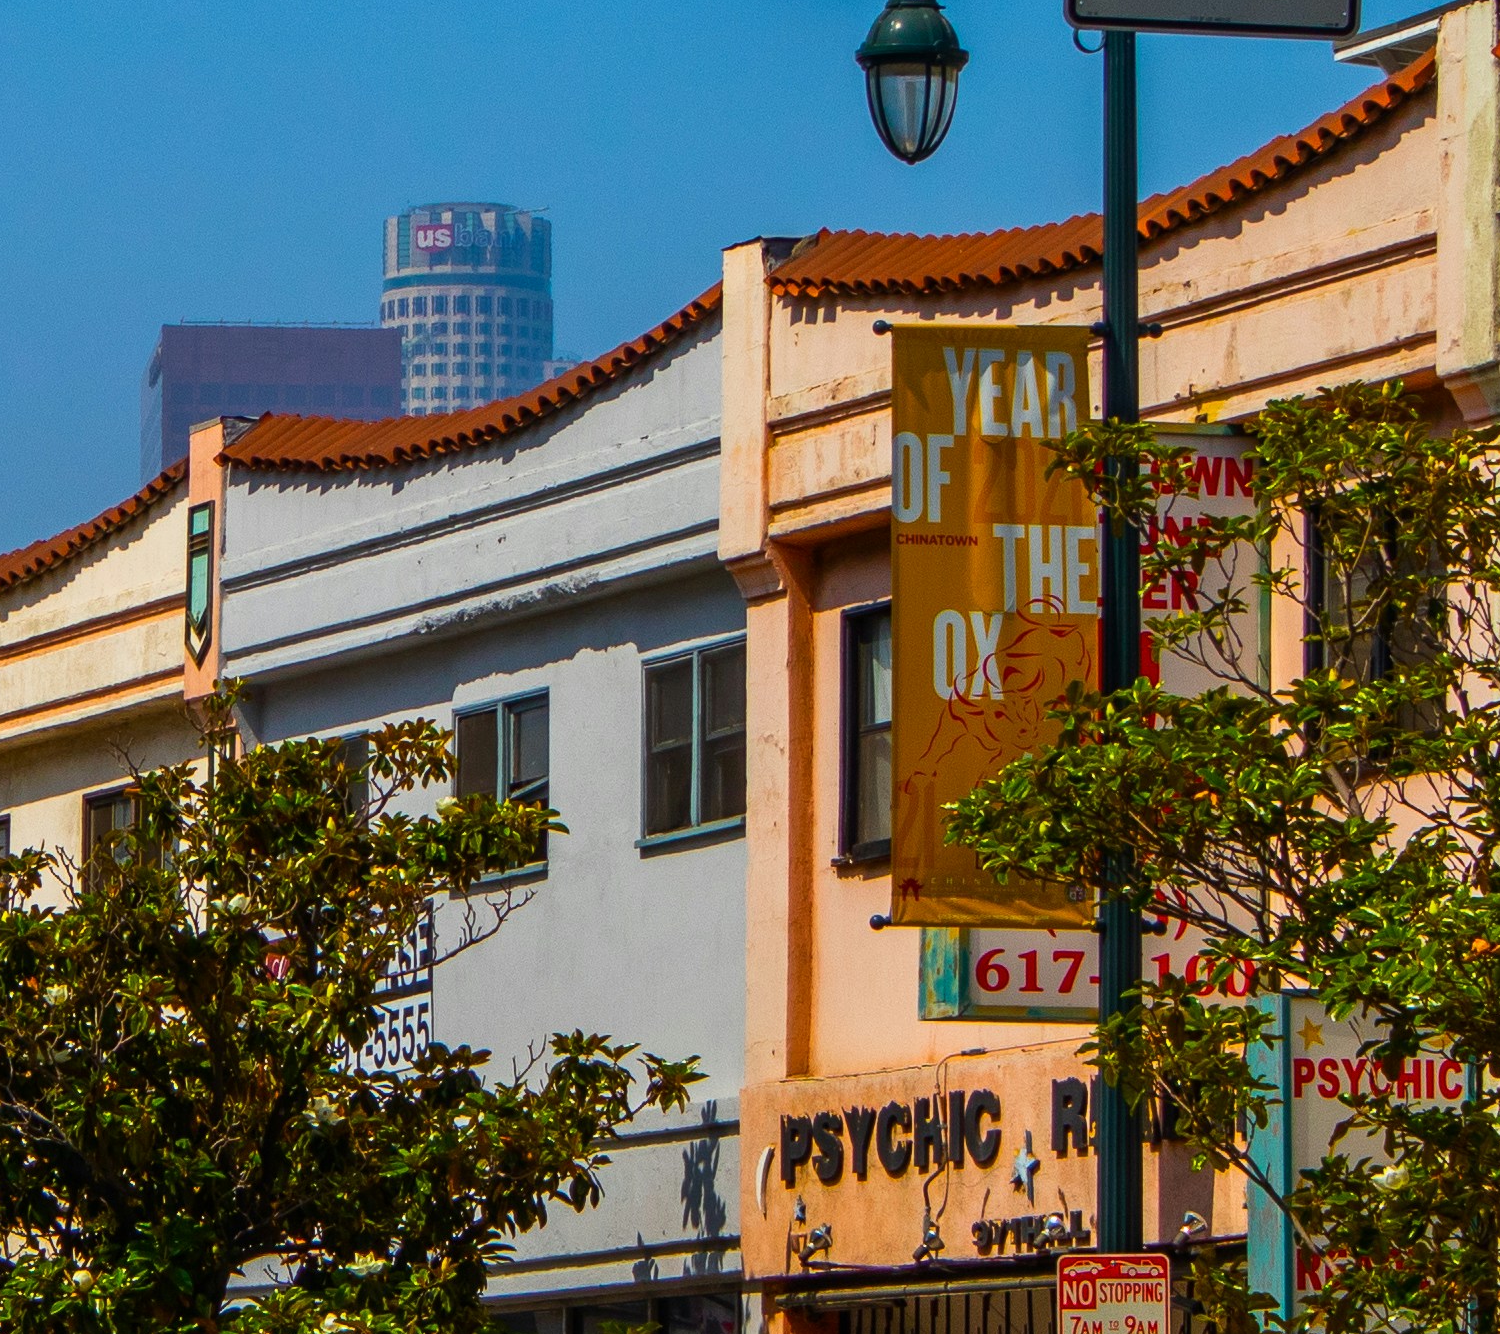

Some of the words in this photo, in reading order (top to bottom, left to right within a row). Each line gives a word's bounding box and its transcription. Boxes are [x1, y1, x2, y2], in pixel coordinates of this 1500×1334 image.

[416, 228, 452, 248] us
[942, 346, 1077, 439] YEAR
[892, 431, 955, 523] OF
[895, 533, 978, 546] CHINATOWN
[993, 524, 1098, 615] THE
[932, 609, 1005, 701] OX
[975, 946, 1258, 998] 617-100
[1292, 1057, 1464, 1100] PSYCHIC
[779, 1088, 1002, 1187] PSYCHIC
[1062, 1281, 1094, 1306] NO
[1099, 1282, 1163, 1304] STOPPING
[1108, 1321, 1120, 1331] TO
